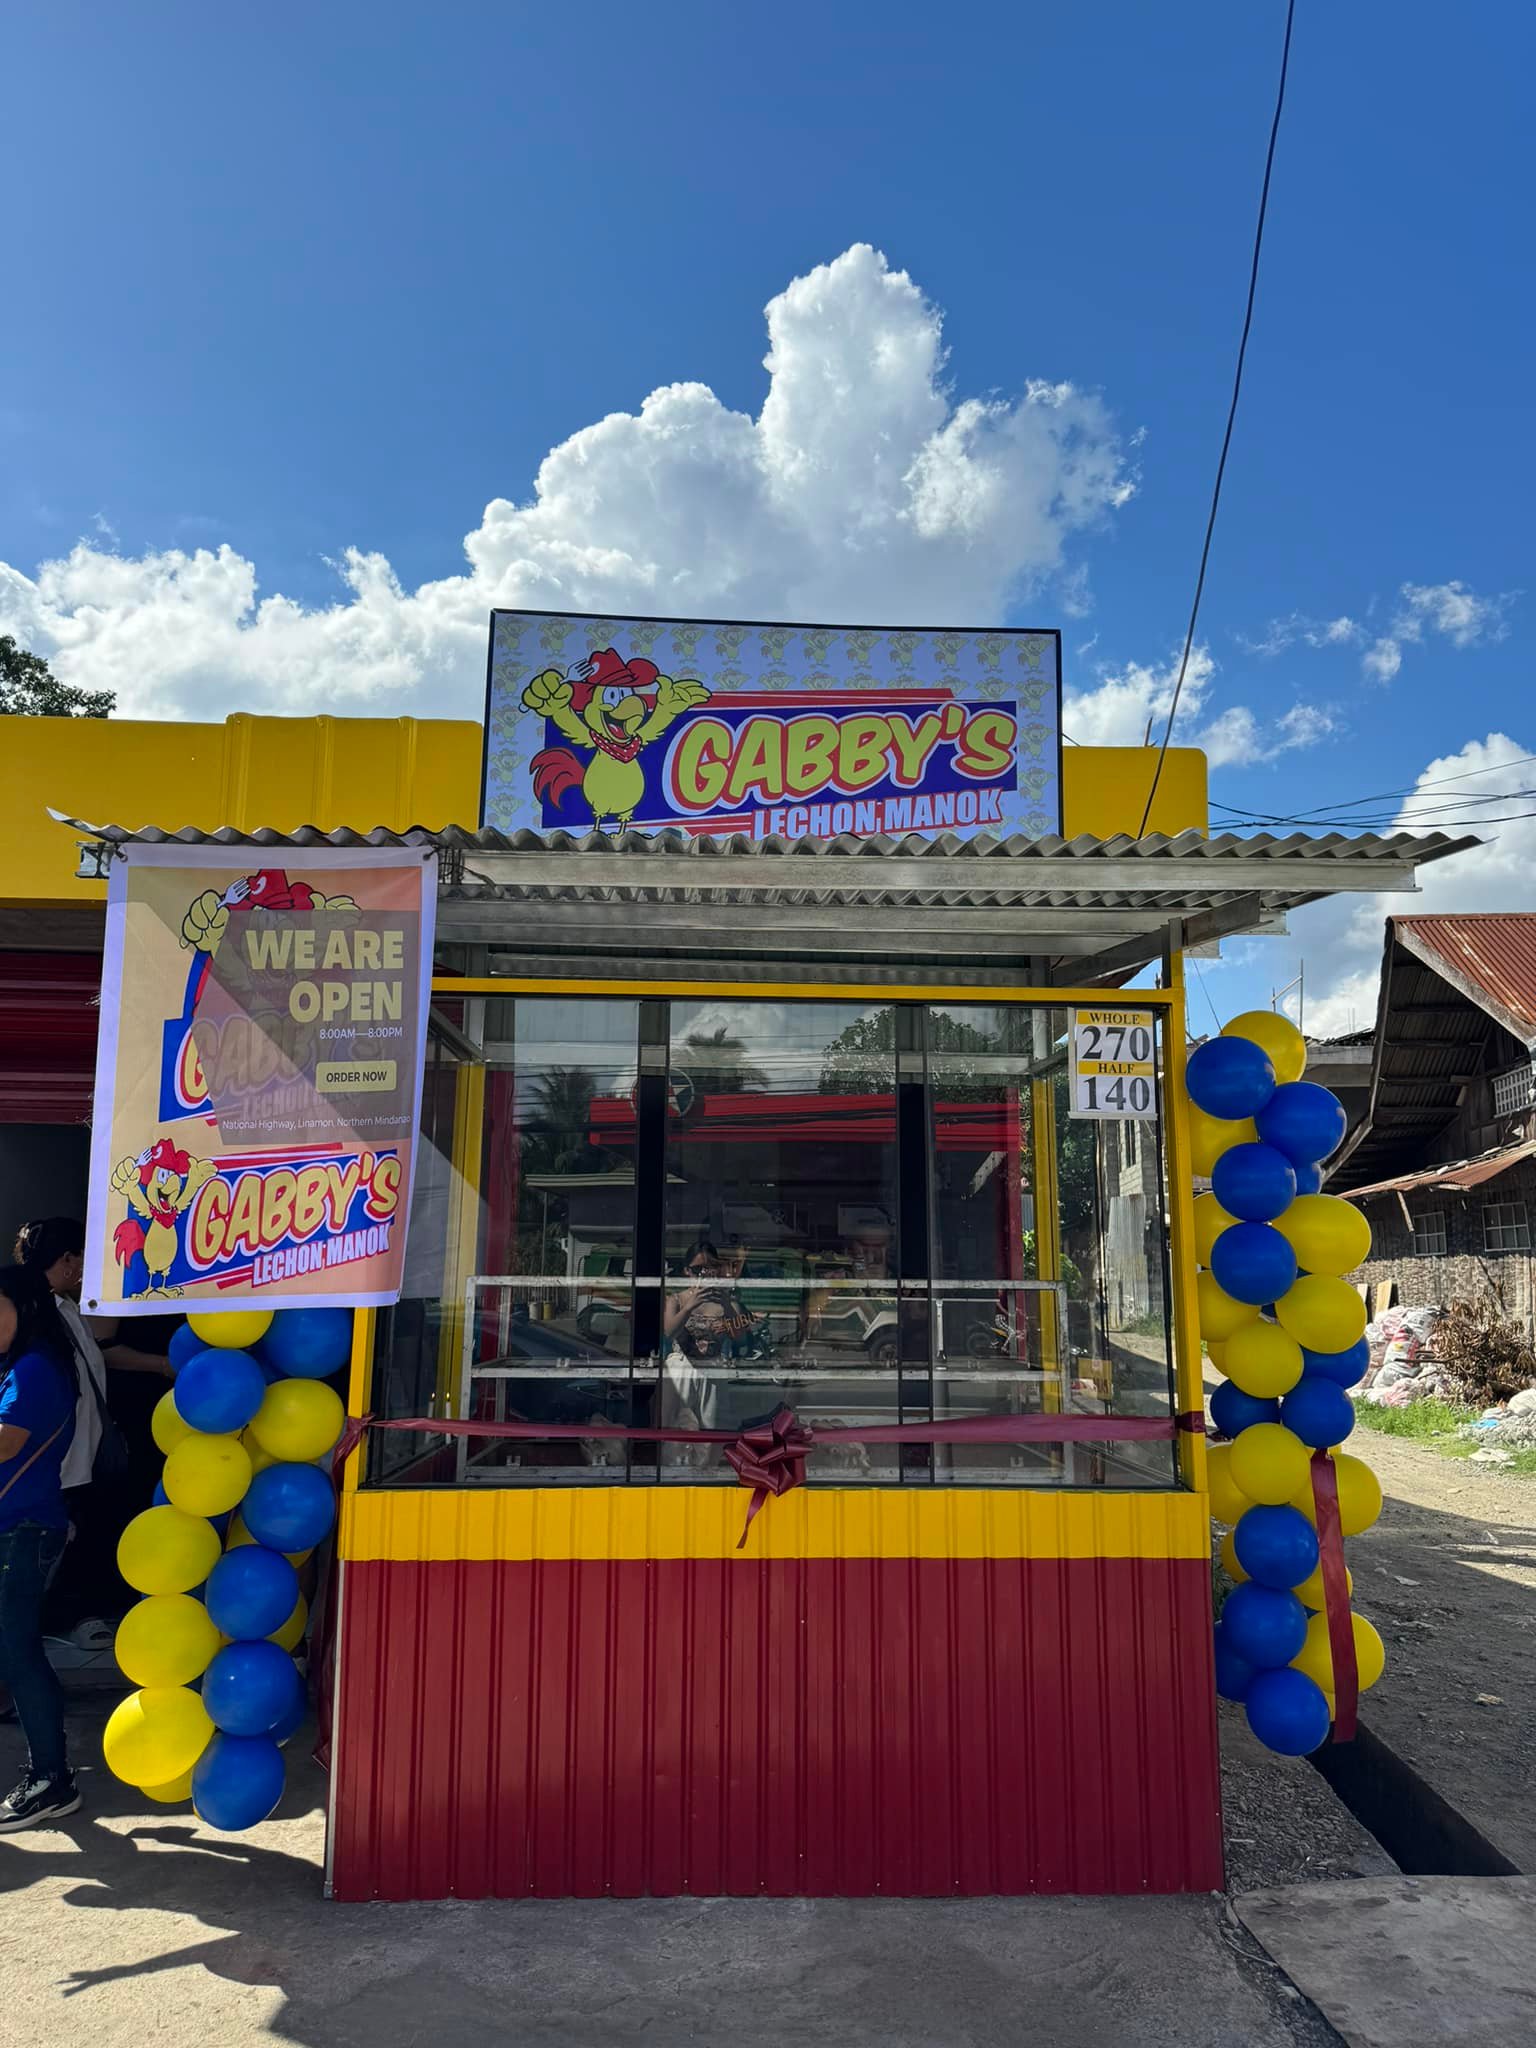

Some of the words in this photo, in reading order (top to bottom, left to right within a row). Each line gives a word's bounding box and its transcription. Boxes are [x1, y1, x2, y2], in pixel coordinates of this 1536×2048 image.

[670, 700, 1018, 811] GABBY'S
[753, 800, 876, 841] LECHON
[884, 789, 1001, 830] MANOK
[246, 930, 315, 970] WE
[322, 930, 404, 970] ARE
[289, 980, 402, 1023] OPEN
[1089, 1012, 1140, 1025] WHOLE
[1082, 1025, 1151, 1061] 270
[326, 1071, 361, 1083] ORDER
[362, 1070, 388, 1082] NOW
[1098, 1063, 1135, 1074] HALF
[1083, 1076, 1150, 1112] 140
[222, 1119, 257, 1130] National
[258, 1119, 297, 1131] Highway,
[337, 1117, 373, 1128] Northern
[374, 1114, 411, 1126] Mindanao
[190, 1151, 402, 1265] GABBY'S
[252, 1241, 323, 1286] LECHON
[325, 1222, 390, 1266] MANOK
